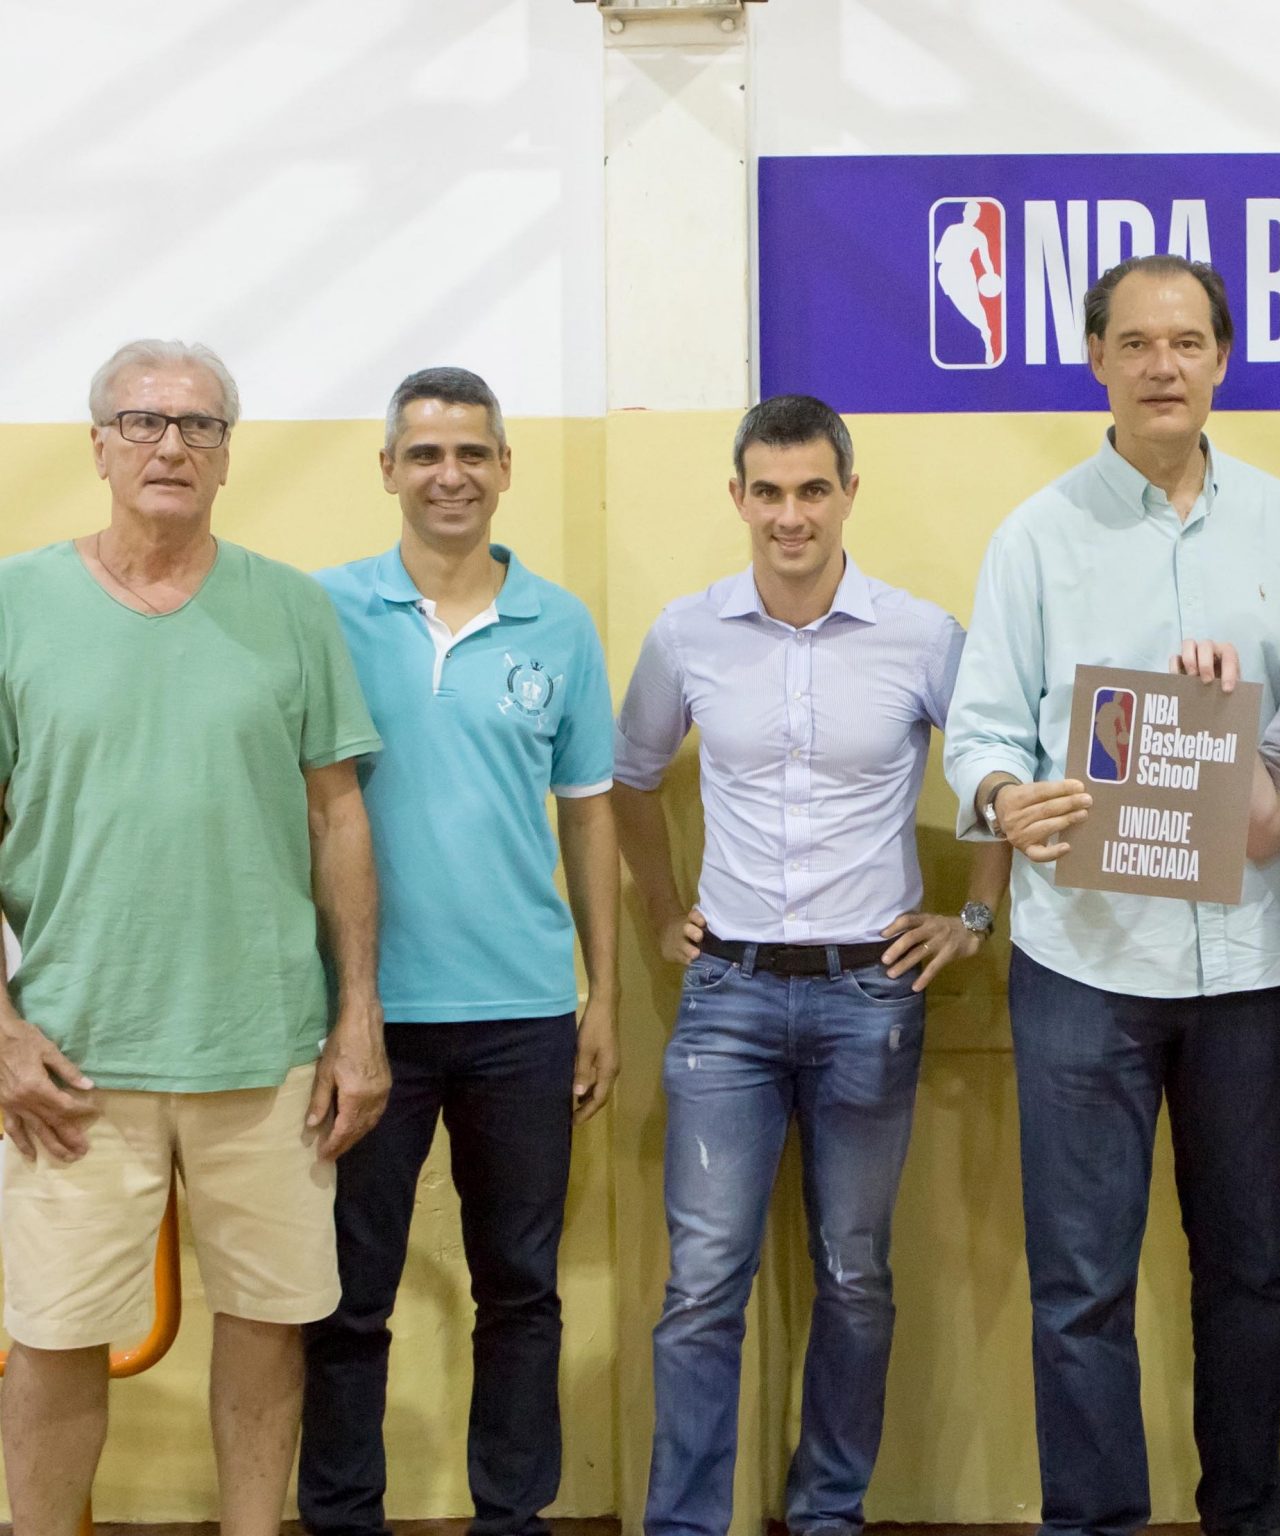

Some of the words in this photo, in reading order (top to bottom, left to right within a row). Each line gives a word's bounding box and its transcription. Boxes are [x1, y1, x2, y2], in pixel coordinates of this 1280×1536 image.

[1143, 693, 1179, 727] NBA
[1139, 724, 1238, 764] Basketball
[1136, 755, 1200, 791] School
[1118, 805, 1193, 844] UNIDADE
[1101, 840, 1199, 882] LICENCIADA
